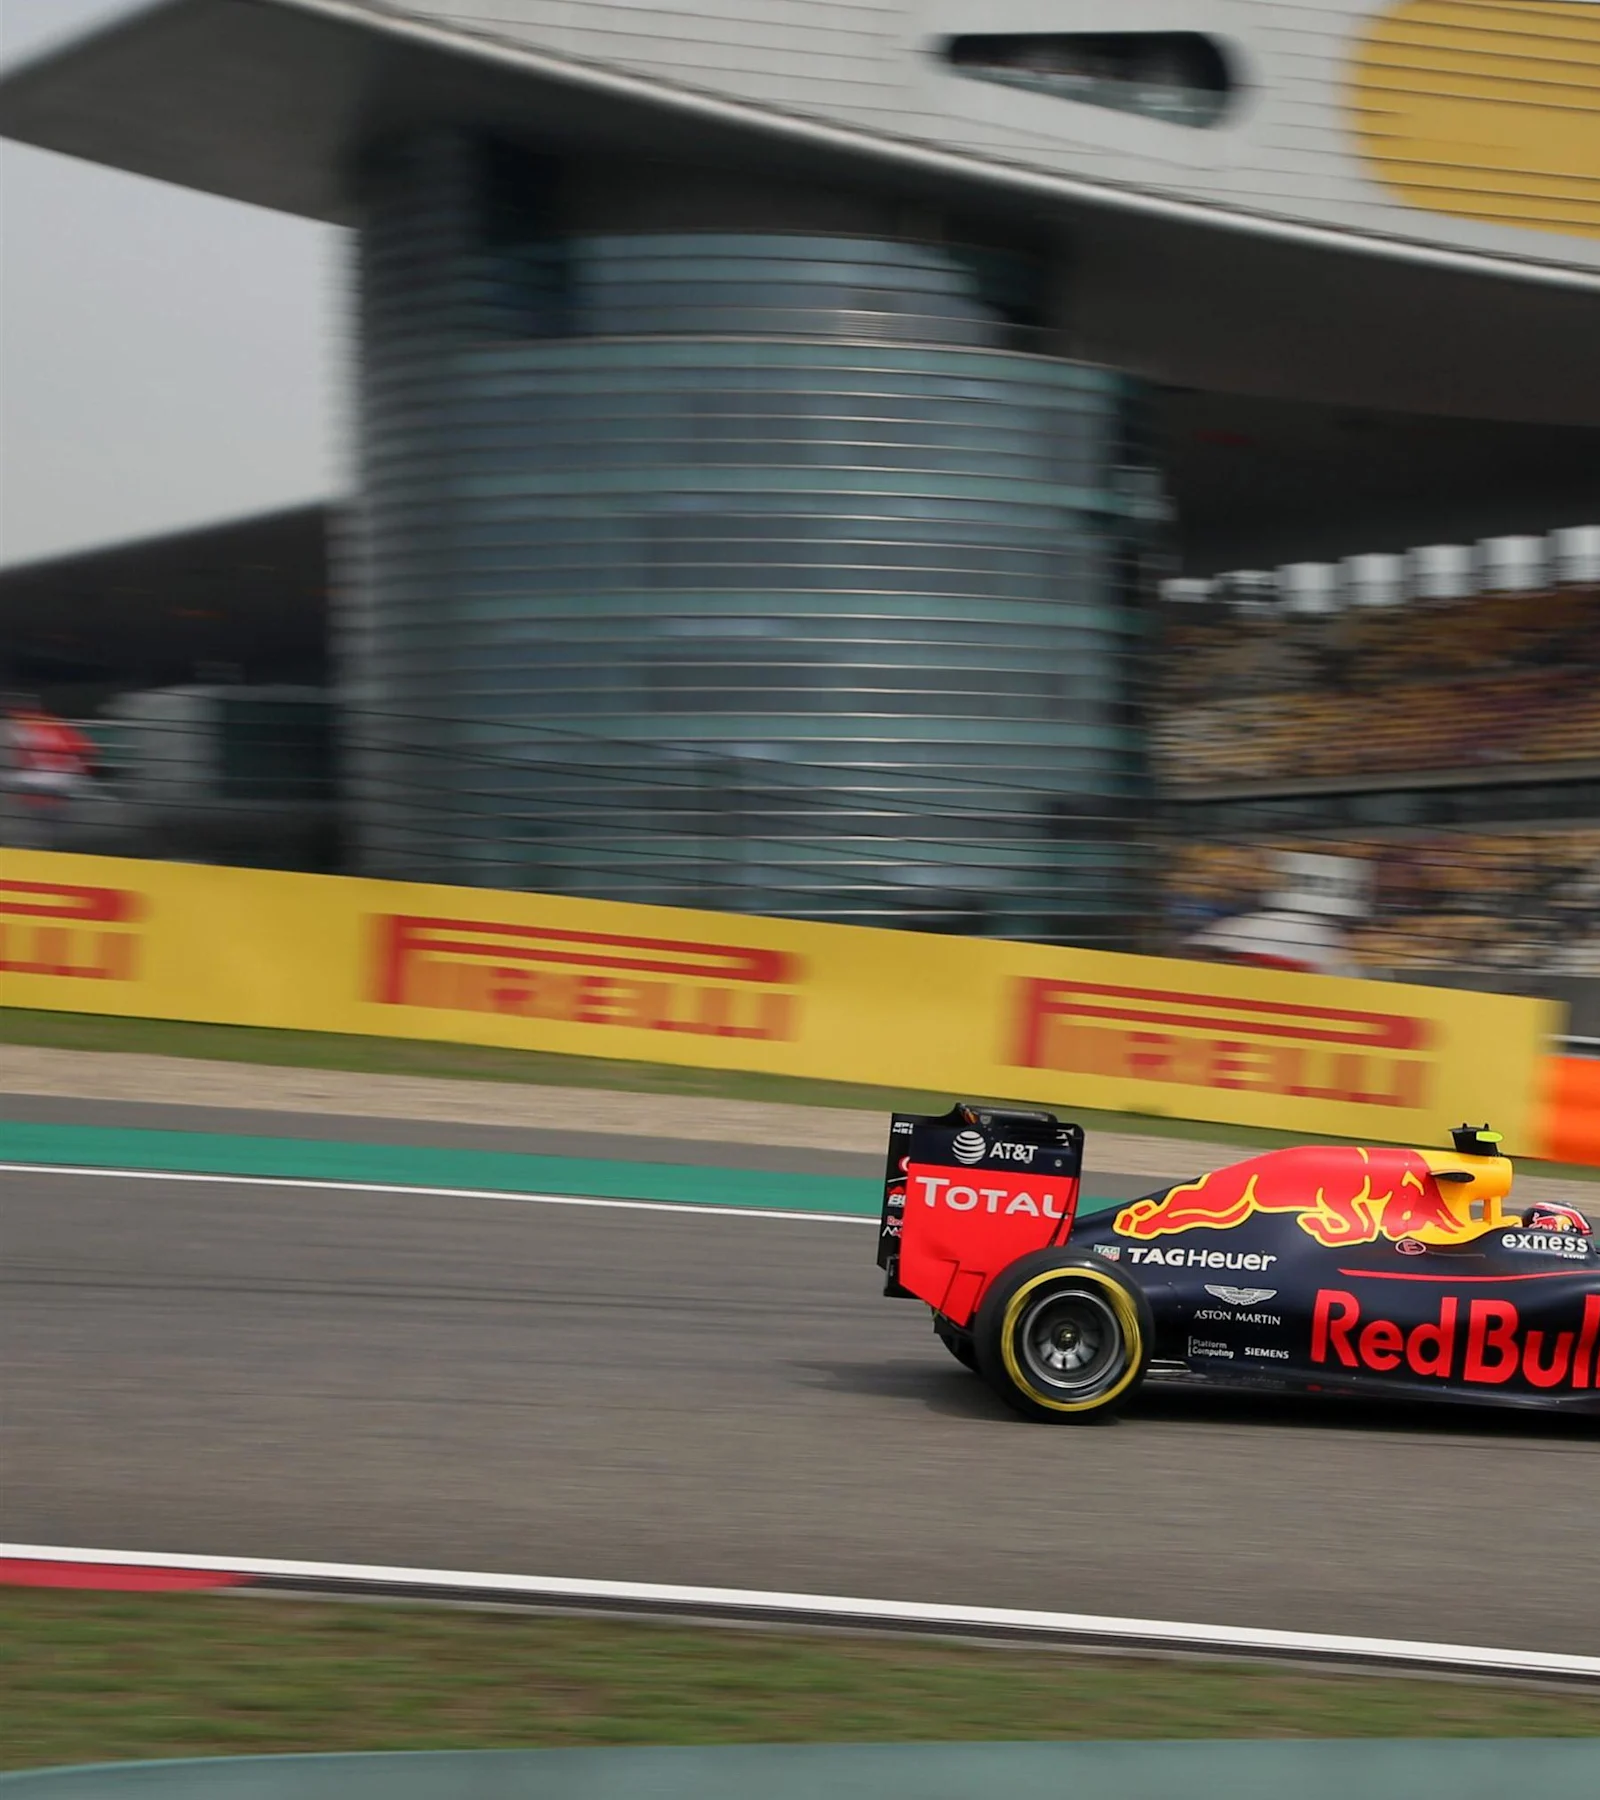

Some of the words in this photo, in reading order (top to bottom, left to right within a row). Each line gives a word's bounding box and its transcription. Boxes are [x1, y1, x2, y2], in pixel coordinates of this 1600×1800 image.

[366, 913, 803, 1041] PIRELLI
[1005, 976, 1441, 1108] PIRELLI
[989, 1142, 1039, 1161] AT&T
[915, 1176, 1069, 1219] TOTAL
[1501, 1233, 1588, 1253] exness
[1194, 1310, 1232, 1320] ASTON
[1235, 1312, 1281, 1325] MARTIN
[1192, 1346, 1234, 1359] Computing
[1244, 1347, 1289, 1359] SIEMENS
